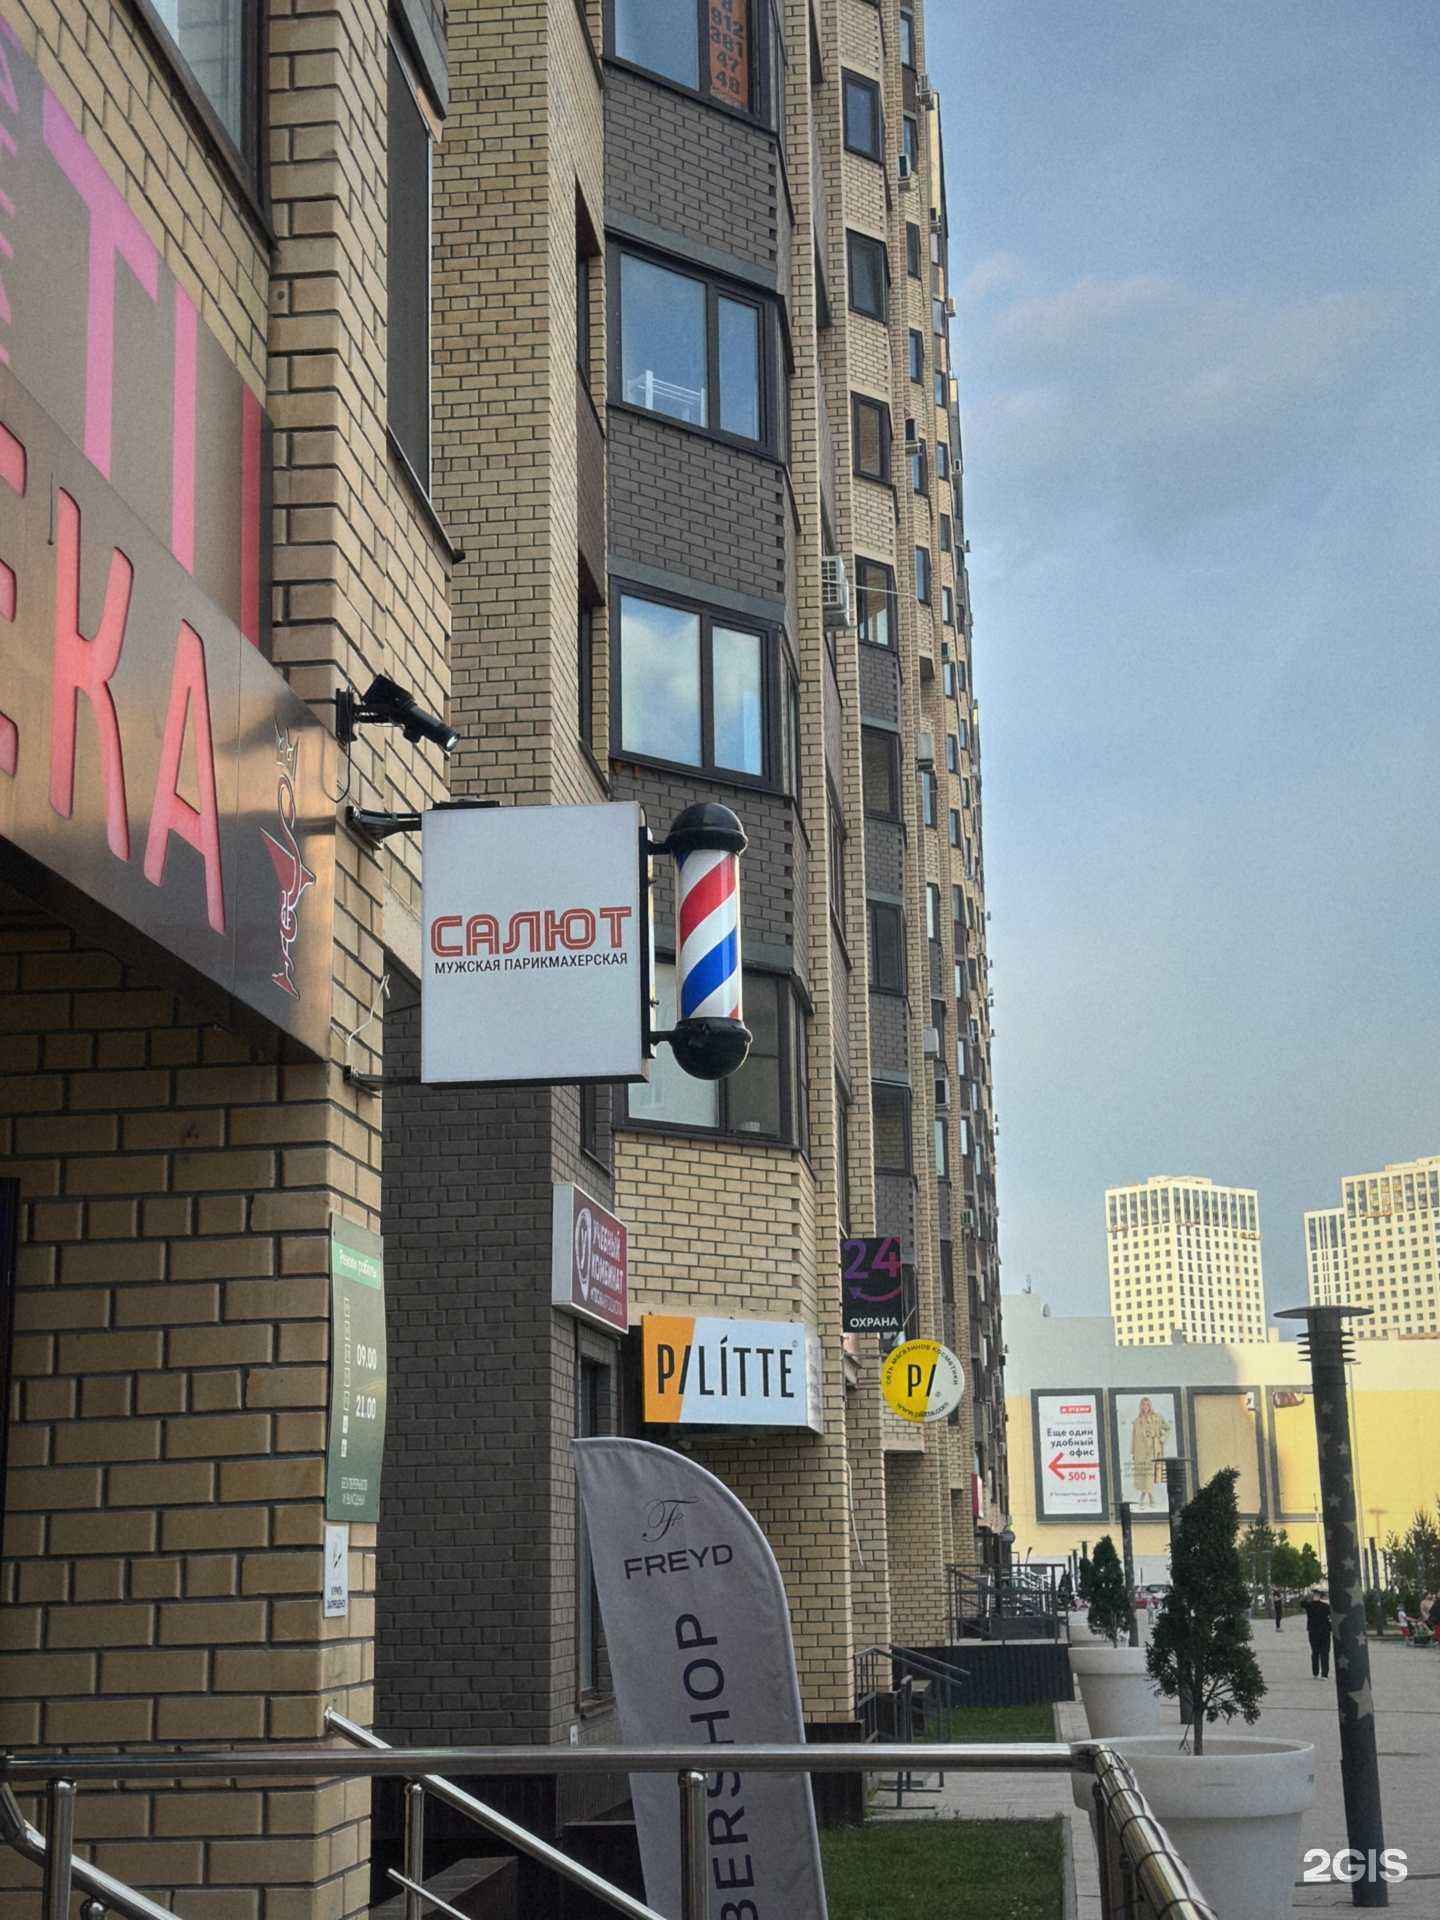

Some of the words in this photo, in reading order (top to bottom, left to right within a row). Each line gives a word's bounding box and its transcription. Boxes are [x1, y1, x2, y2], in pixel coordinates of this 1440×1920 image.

[430, 906, 632, 957] САЛЮТ
[434, 958, 501, 975] МУЖСКАЯ
[504, 952, 628, 971] ПАРИКМАХЕРСКАЯ
[843, 1235, 903, 1279] 24
[850, 1316, 899, 1328] ОХРАНА
[1047, 1428, 1067, 1437] Еще
[1068, 1429, 1094, 1437] один
[1050, 1437, 1094, 1448] удобный
[1069, 1448, 1095, 1458] офис
[1068, 1472, 1086, 1481] 500
[623, 1544, 733, 1580] FREYD
